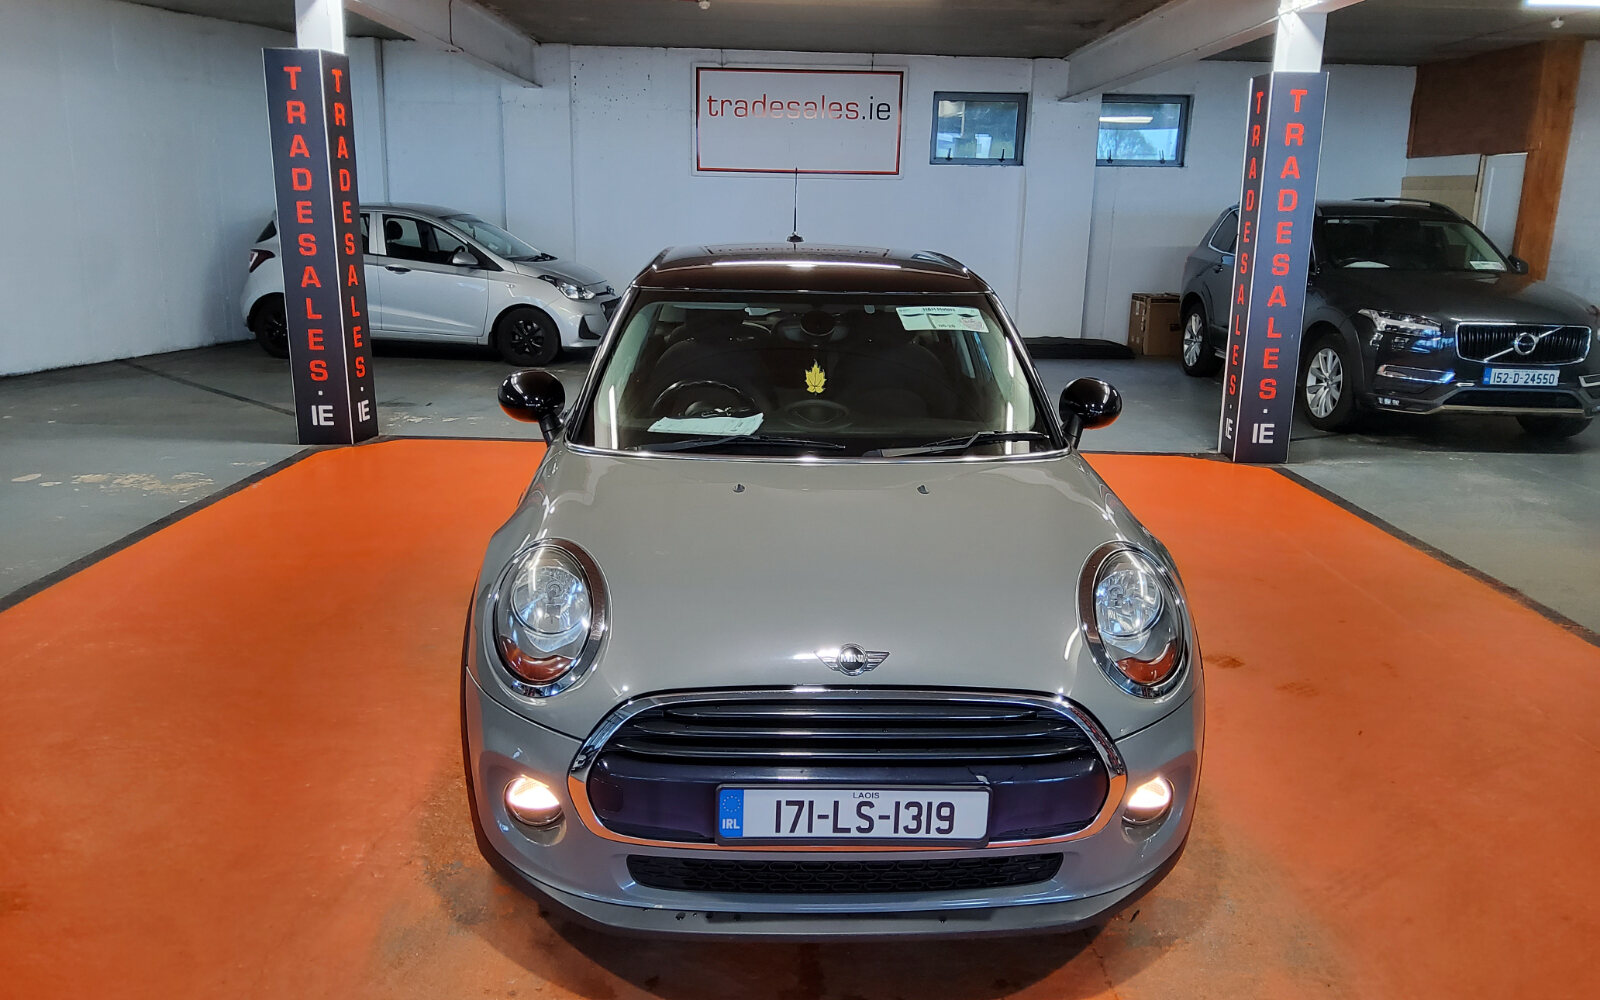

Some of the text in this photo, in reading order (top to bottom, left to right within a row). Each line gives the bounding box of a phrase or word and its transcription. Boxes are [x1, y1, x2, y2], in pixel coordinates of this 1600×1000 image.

[707, 93, 891, 121] tradesales.ie
[1493, 372, 1555, 384] 152-D-24550
[852, 791, 880, 799] LAOIS
[774, 799, 956, 835] 171-LS-1319
[721, 818, 740, 830] IRL
